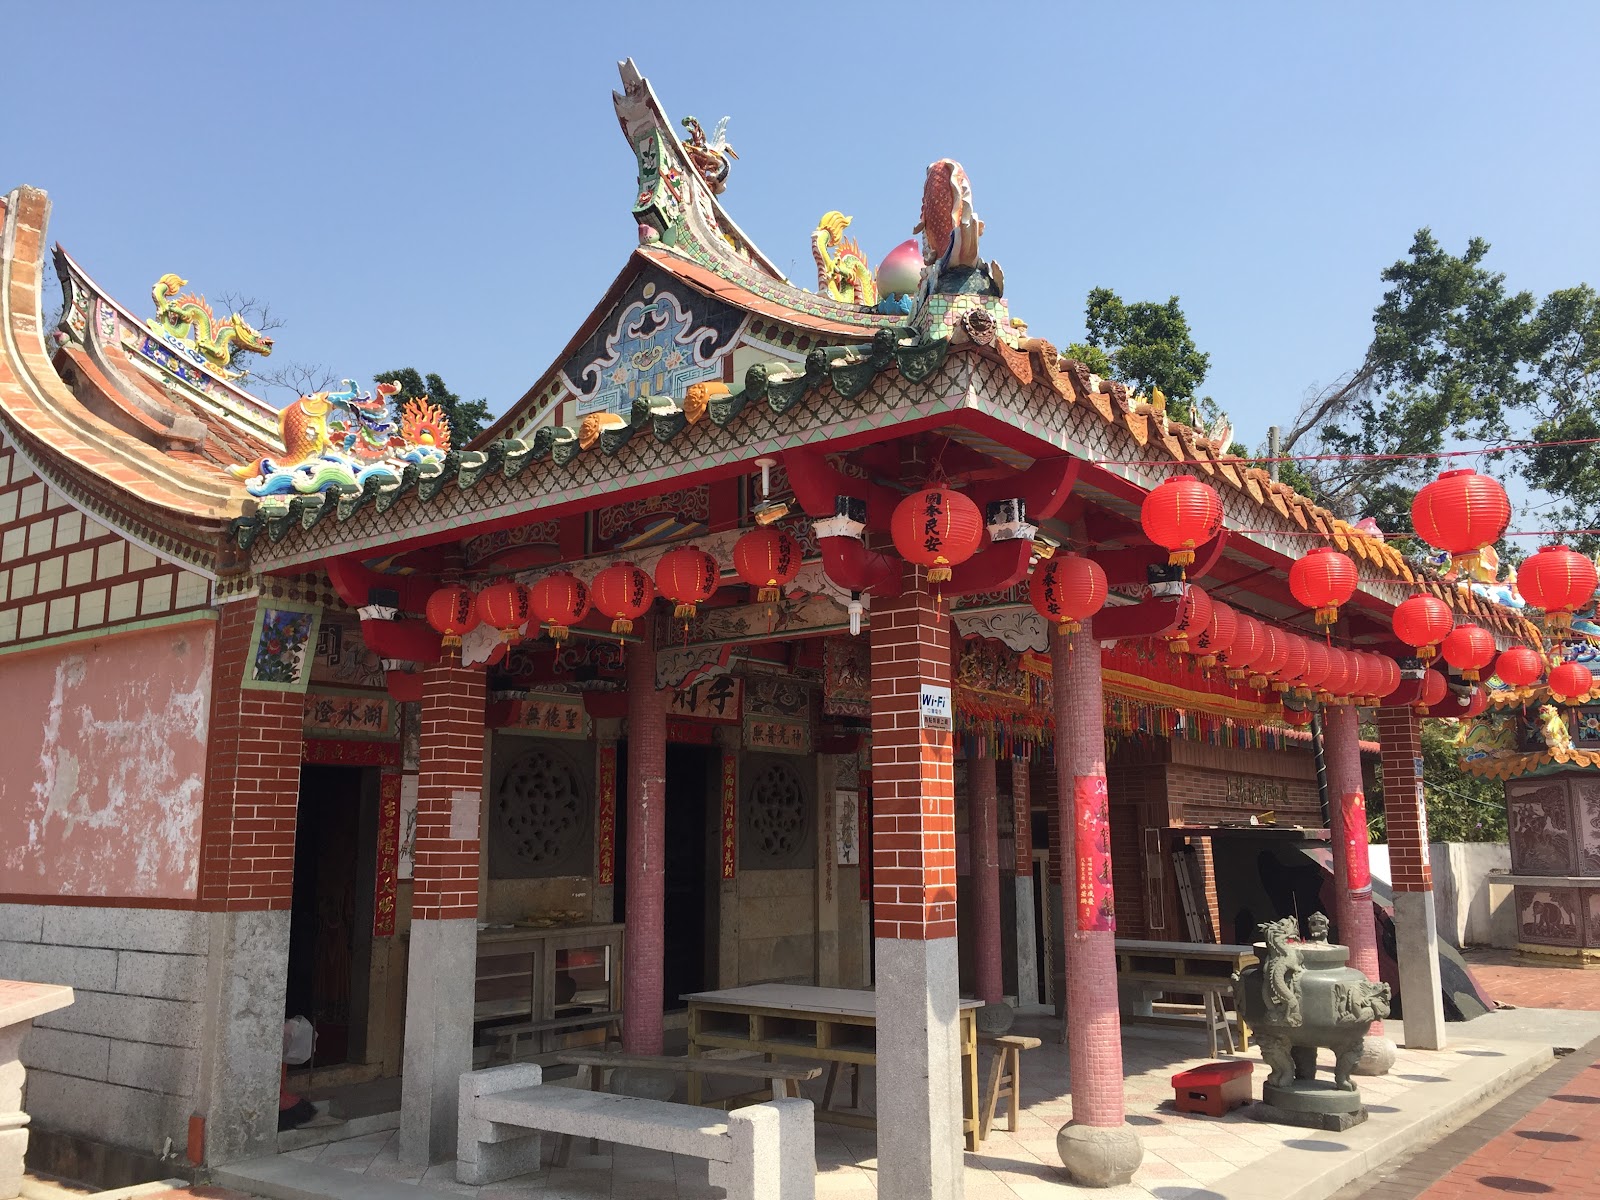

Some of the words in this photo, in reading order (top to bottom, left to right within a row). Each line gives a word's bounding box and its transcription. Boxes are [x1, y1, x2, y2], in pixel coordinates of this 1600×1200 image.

[924, 492, 943, 552] 國泰民安
[703, 555, 717, 595] 風調雨順
[776, 536, 793, 576] 風調雨順
[631, 570, 647, 608] 風調雨順
[1042, 562, 1061, 615] 國泰民安
[304, 699, 384, 729] 湖水澄
[922, 693, 947, 708] Wi-Fi
